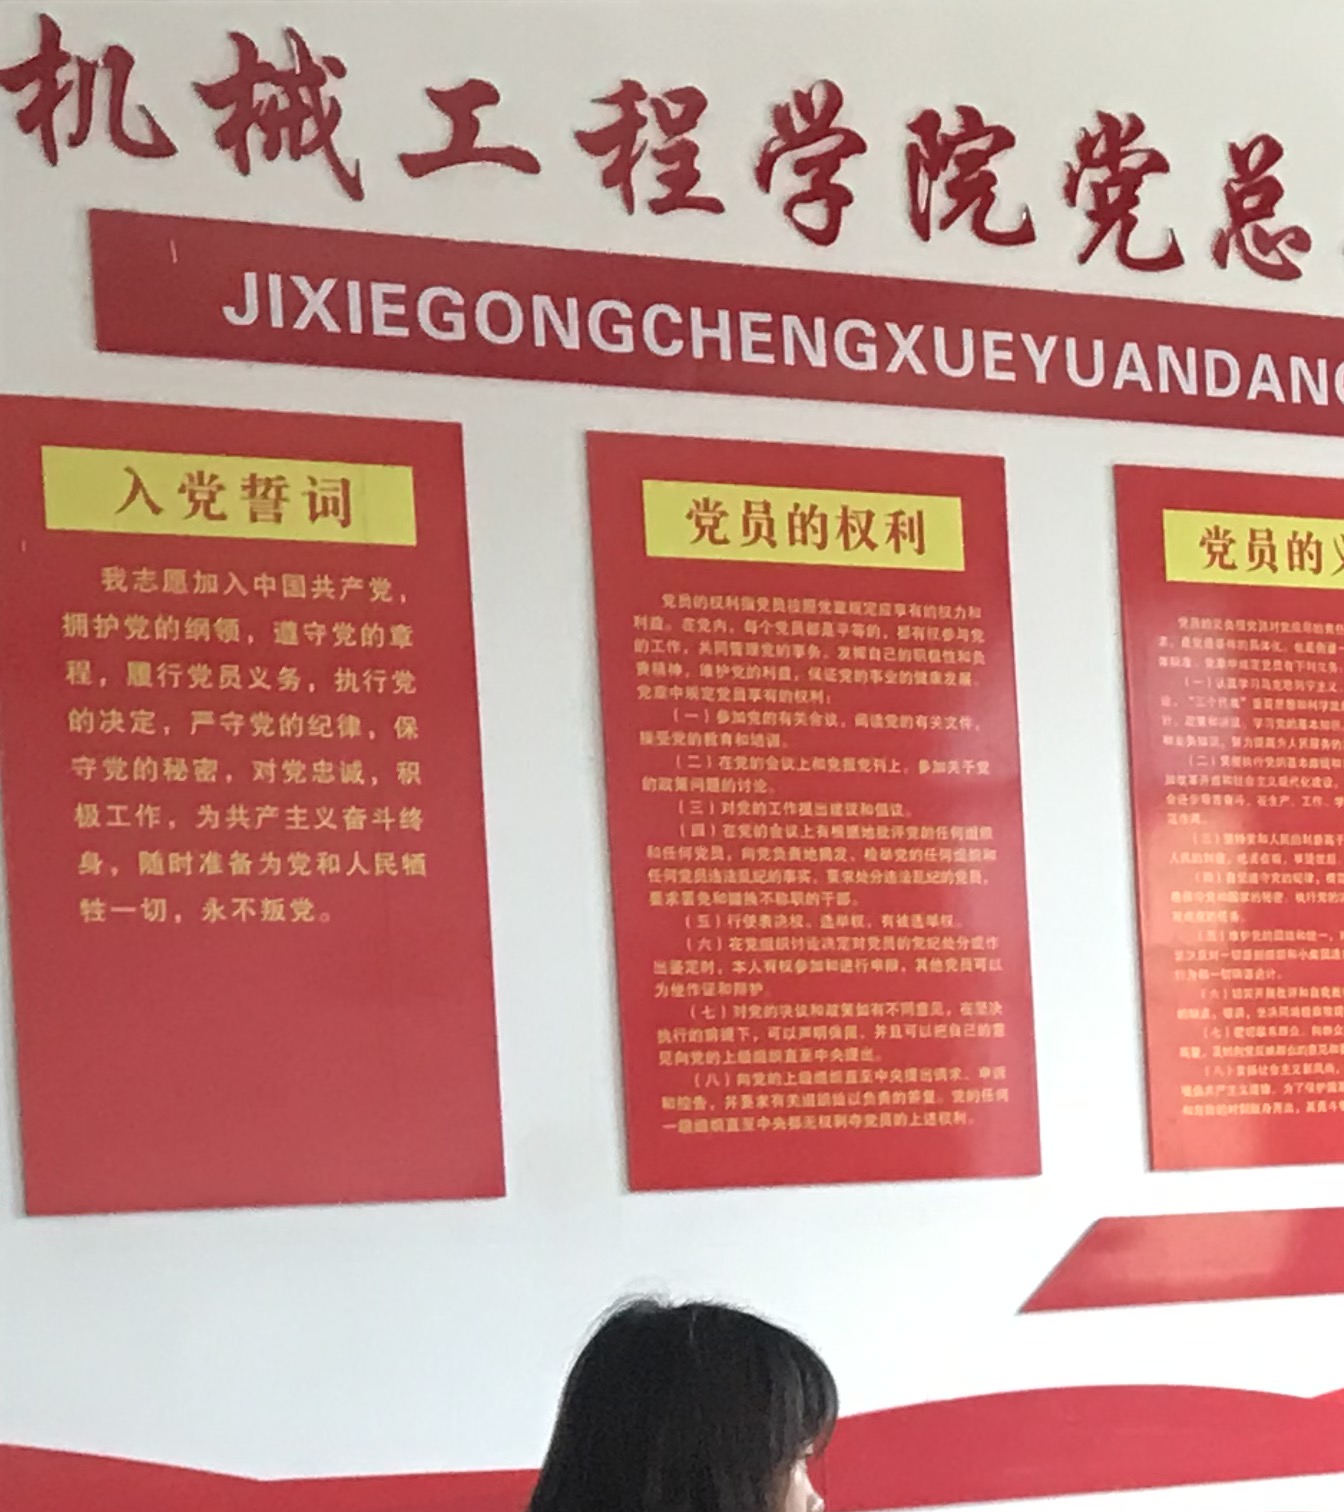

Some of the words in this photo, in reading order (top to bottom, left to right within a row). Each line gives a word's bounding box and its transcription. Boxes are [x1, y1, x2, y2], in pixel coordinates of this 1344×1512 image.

[115, 467, 353, 528] 入党誓词
[686, 496, 925, 555] 党员的权利
[99, 564, 406, 604] 我志愿加入中国共产党，
[60, 610, 414, 650] 拥护党的纲领，遵守党的章
[63, 658, 416, 695] 程，履行党员义务，执行党
[66, 706, 419, 740] 的决定，严守党的纪律，保
[70, 755, 421, 785] 守党的秘密，对党忠诚，积
[72, 802, 423, 830] 极工作，为共产主义奋斗终
[76, 850, 427, 877] 身，随时准备为党和人民牺
[78, 896, 329, 924] 牲一切，永不叛党。
